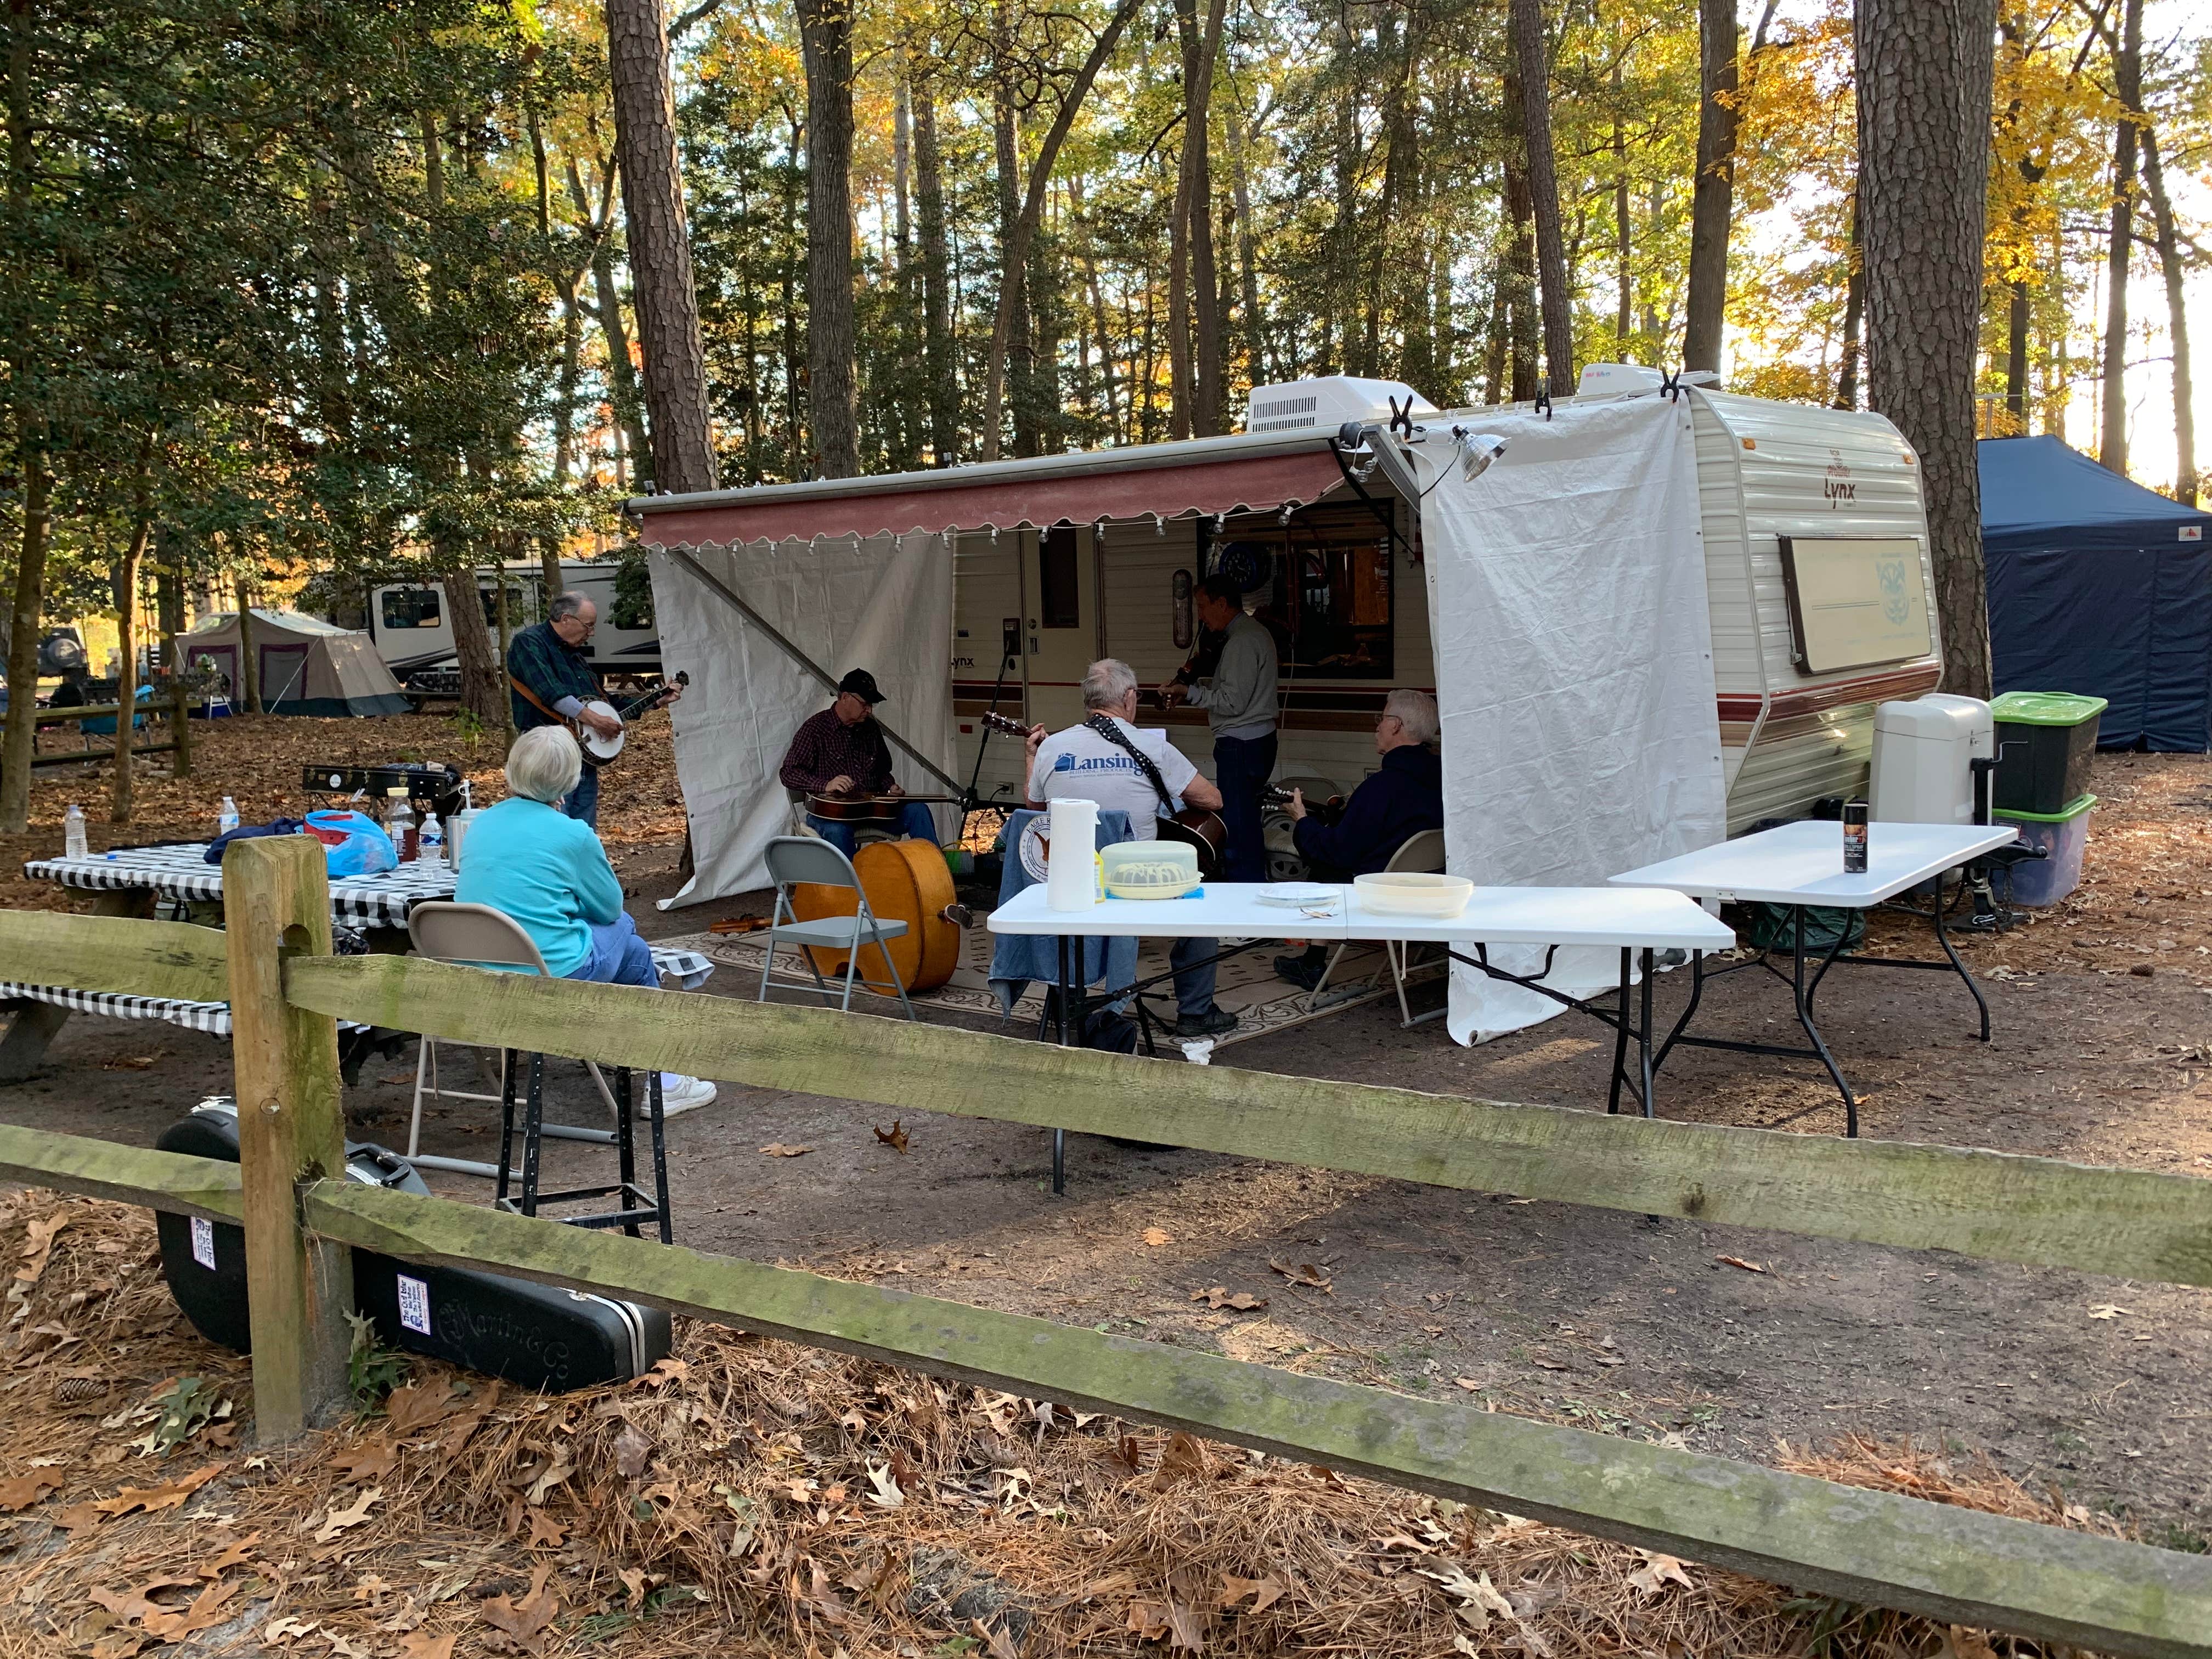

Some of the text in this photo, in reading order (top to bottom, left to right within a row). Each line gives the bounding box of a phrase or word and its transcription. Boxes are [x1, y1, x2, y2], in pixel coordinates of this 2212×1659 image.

[1824, 478, 1856, 510] Lynx
[951, 657, 975, 670] ynx
[1070, 753, 1144, 776] Lansing
[1026, 817, 1046, 833] EAGLE
